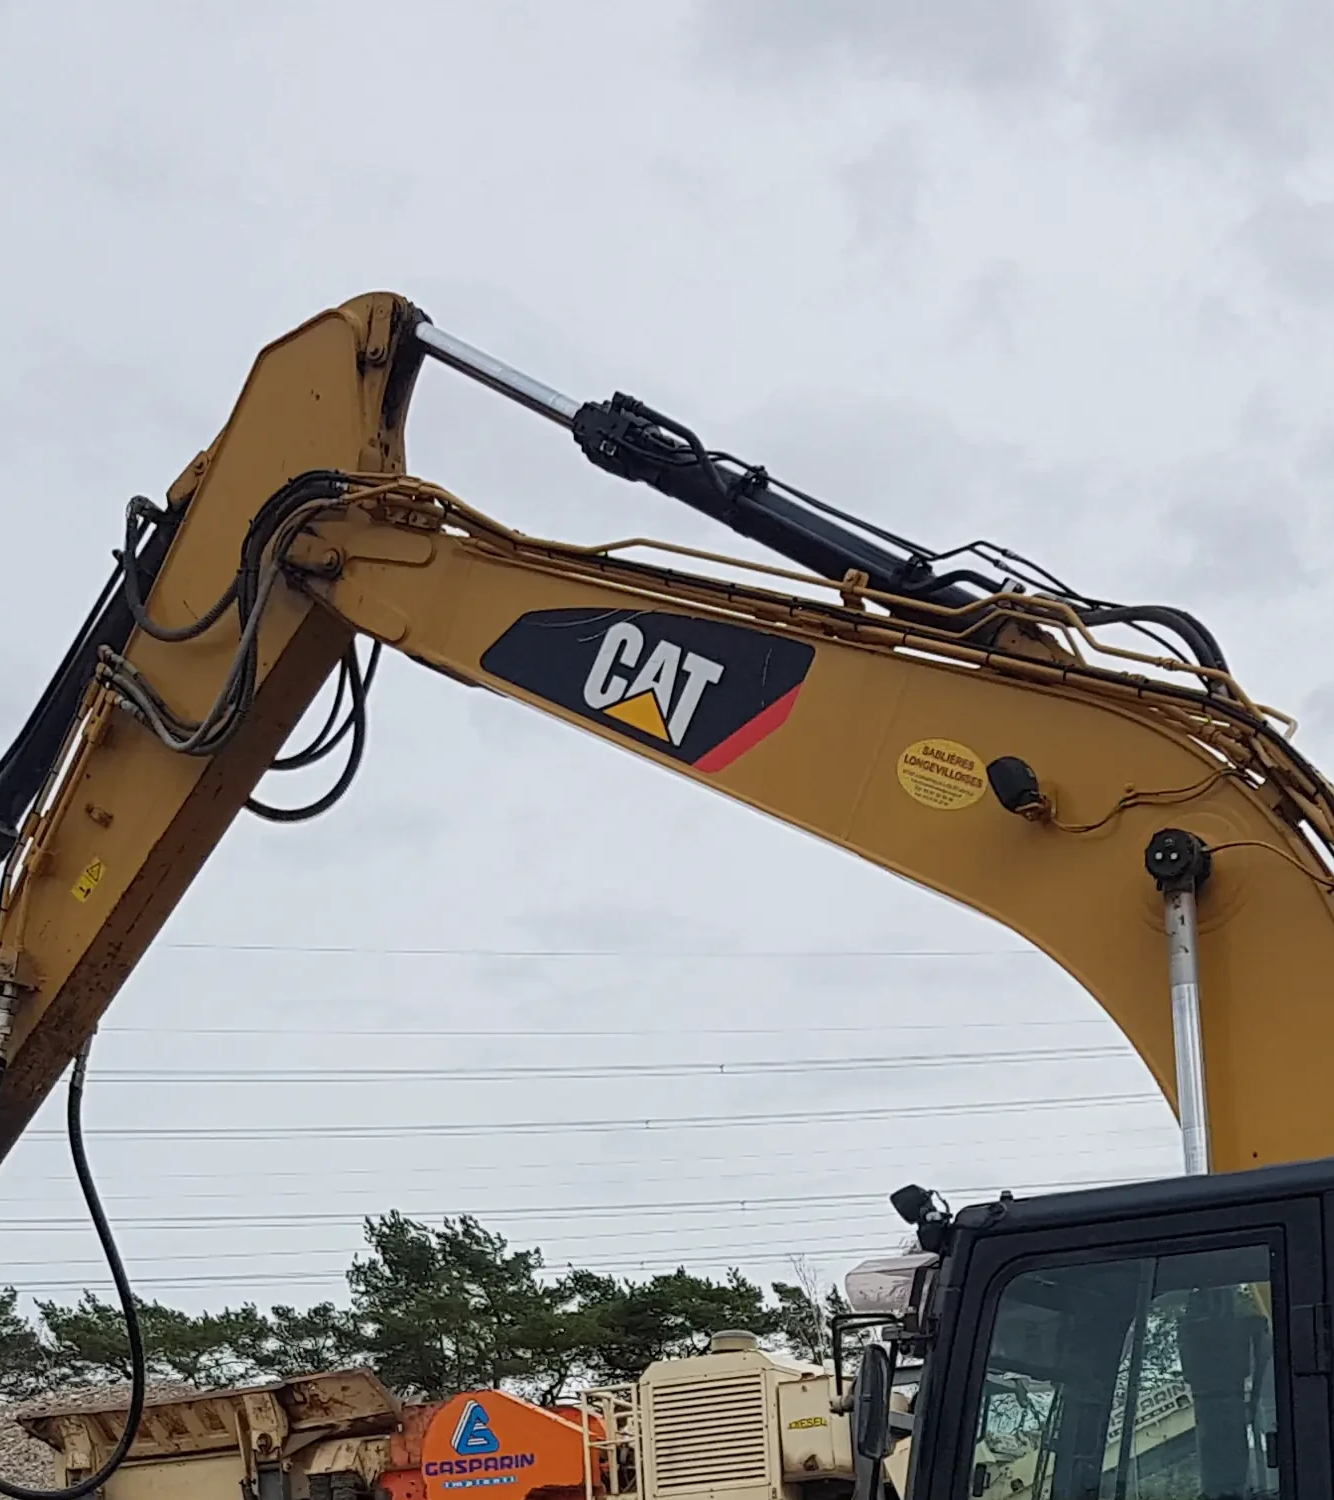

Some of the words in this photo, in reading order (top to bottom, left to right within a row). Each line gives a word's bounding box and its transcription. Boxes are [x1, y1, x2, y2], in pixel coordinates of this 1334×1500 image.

[583, 621, 725, 747] CAT
[903, 753, 984, 789] LONGEVILLOISES
[424, 1453, 535, 1477] GASPARIN
